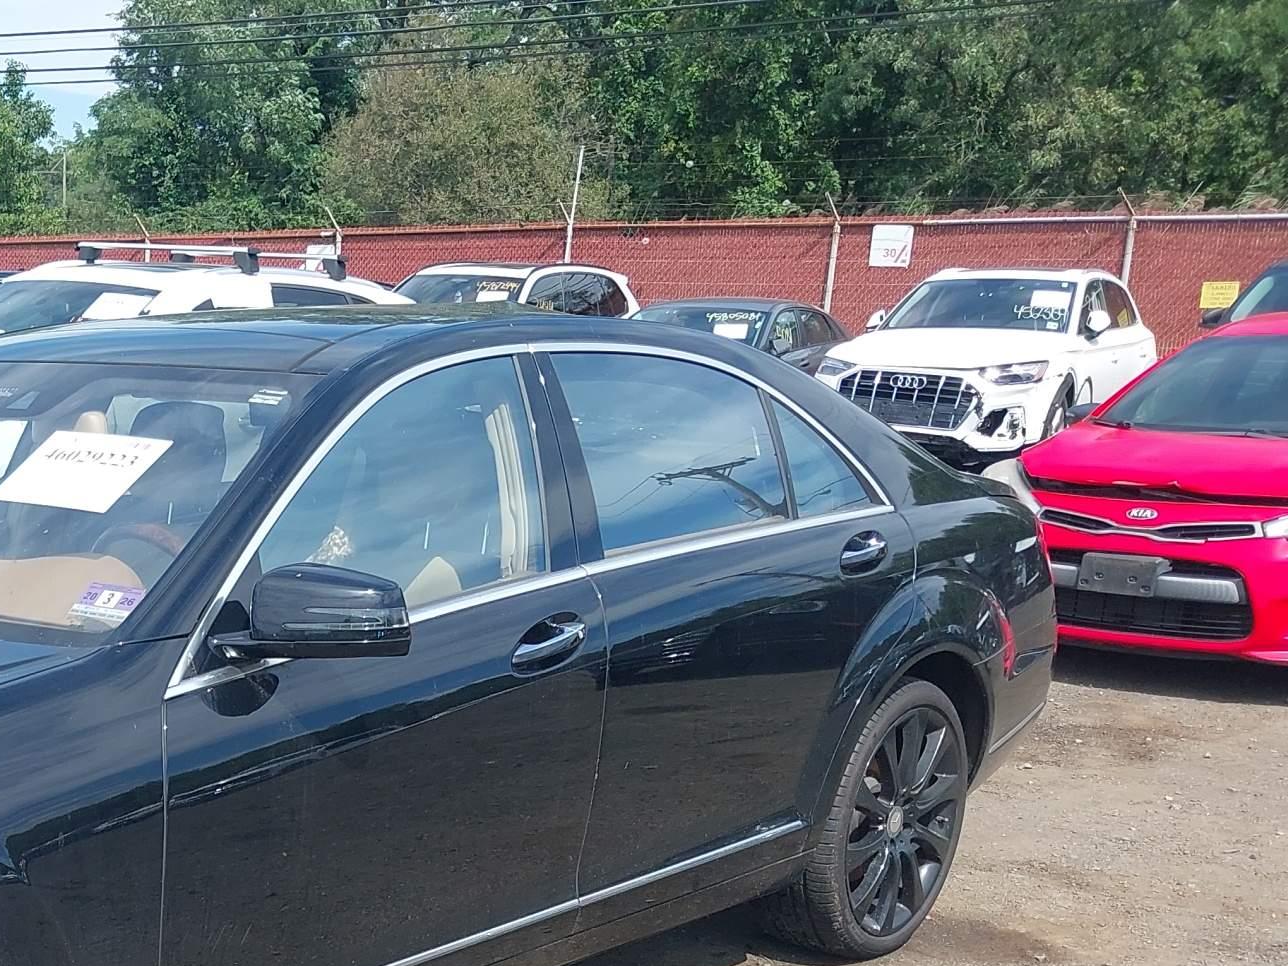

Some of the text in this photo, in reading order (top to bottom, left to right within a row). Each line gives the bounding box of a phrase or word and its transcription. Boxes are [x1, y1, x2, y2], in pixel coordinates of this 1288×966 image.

[82, 591, 136, 607] 20 3 26
